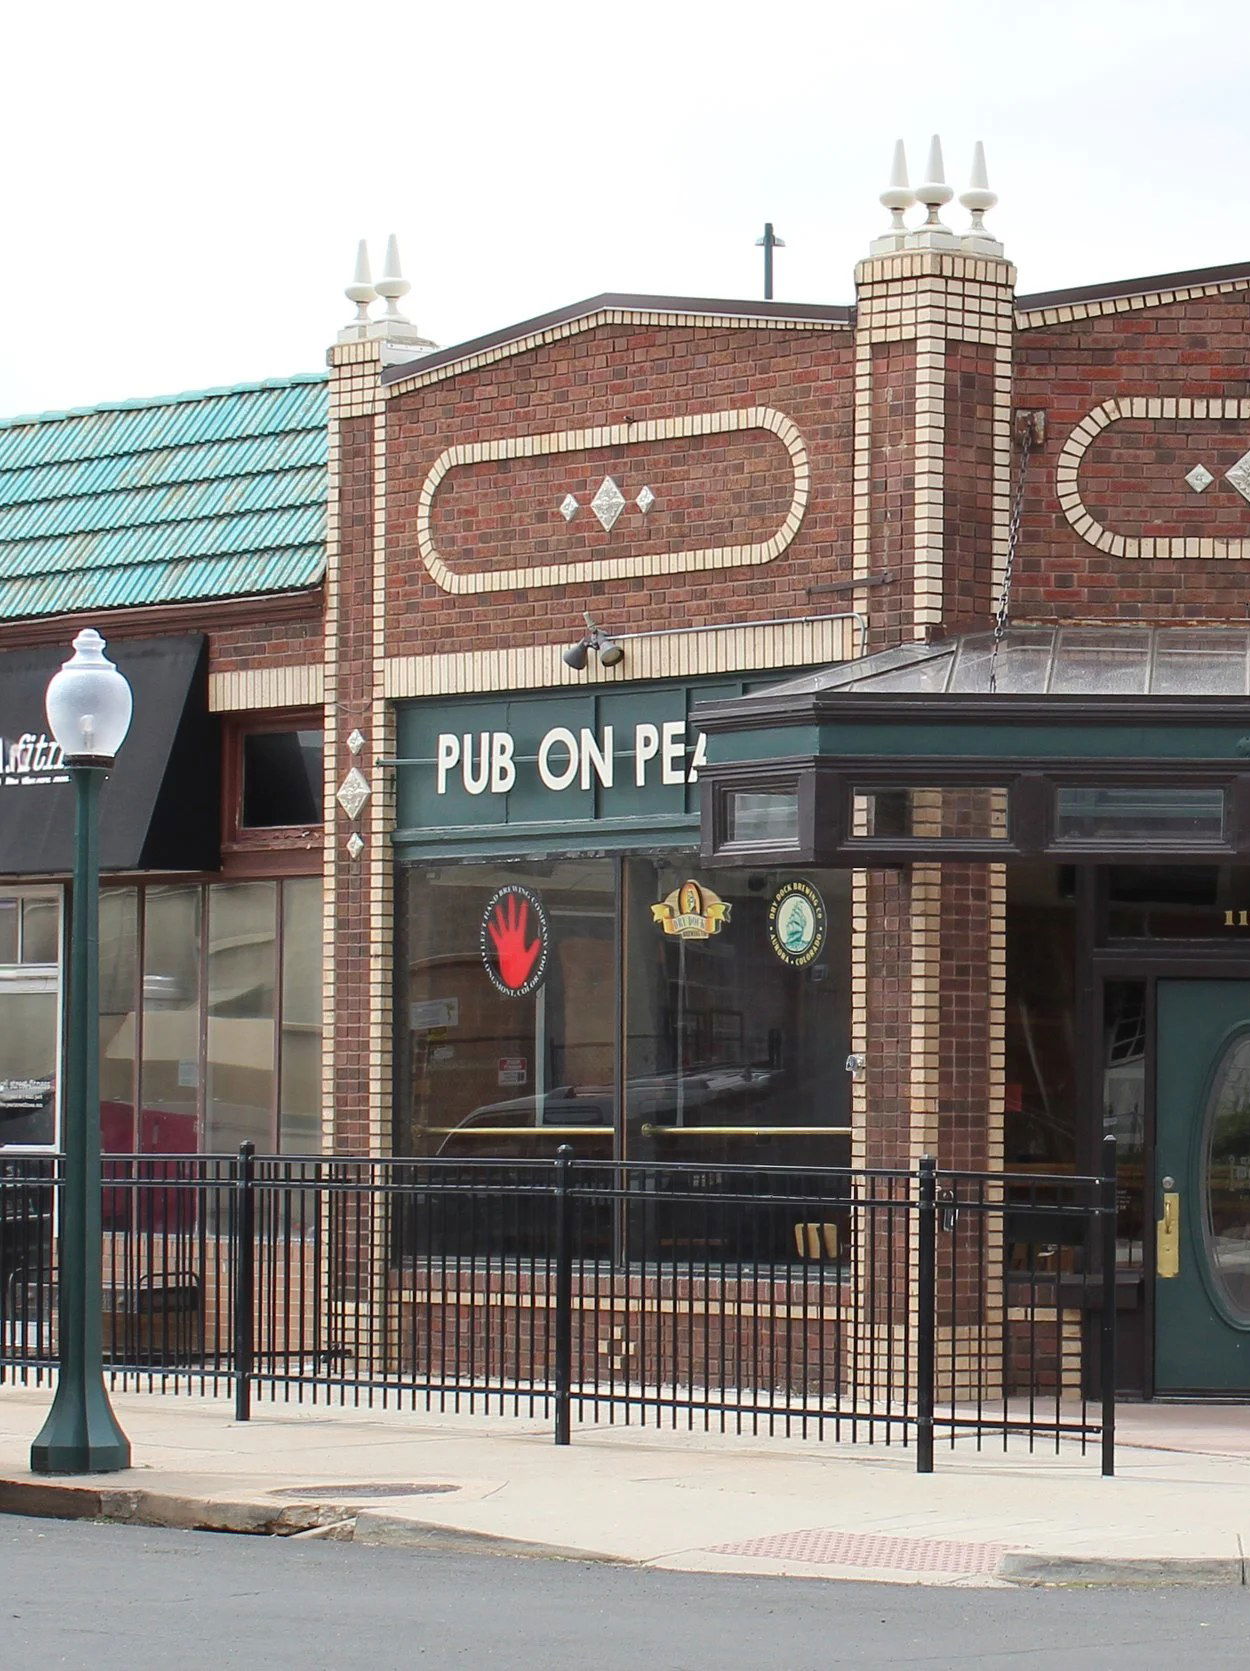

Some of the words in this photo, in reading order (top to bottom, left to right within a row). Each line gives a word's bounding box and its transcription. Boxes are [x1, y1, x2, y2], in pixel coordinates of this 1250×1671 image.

[437, 731, 517, 795] PUB
[538, 725, 614, 791] ON
[775, 884, 793, 902] DOCK
[793, 882, 819, 907] BREWING
[770, 933, 790, 965] AURORA
[795, 933, 822, 966] COLORADO
